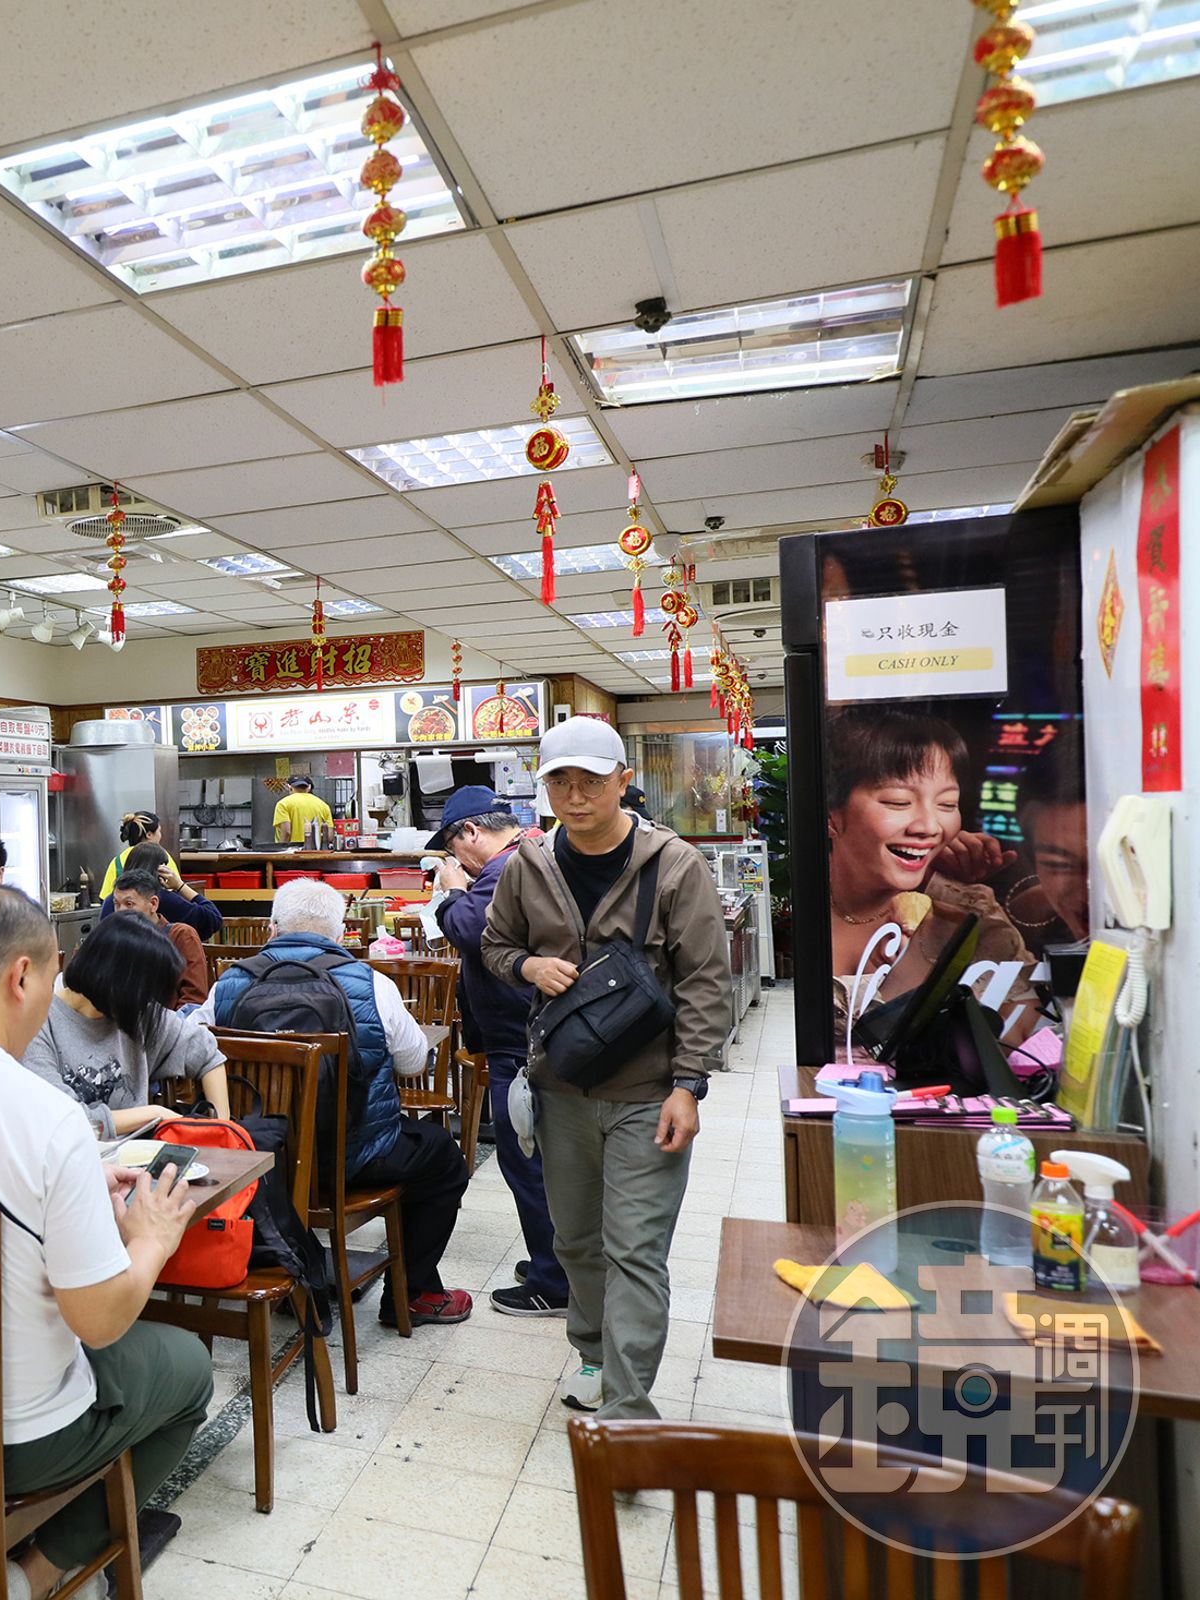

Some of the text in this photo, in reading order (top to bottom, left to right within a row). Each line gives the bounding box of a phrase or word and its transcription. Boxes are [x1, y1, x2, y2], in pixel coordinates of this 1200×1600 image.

[876, 620, 960, 641] 只收現金
[878, 655, 959, 671] CASH ONLY
